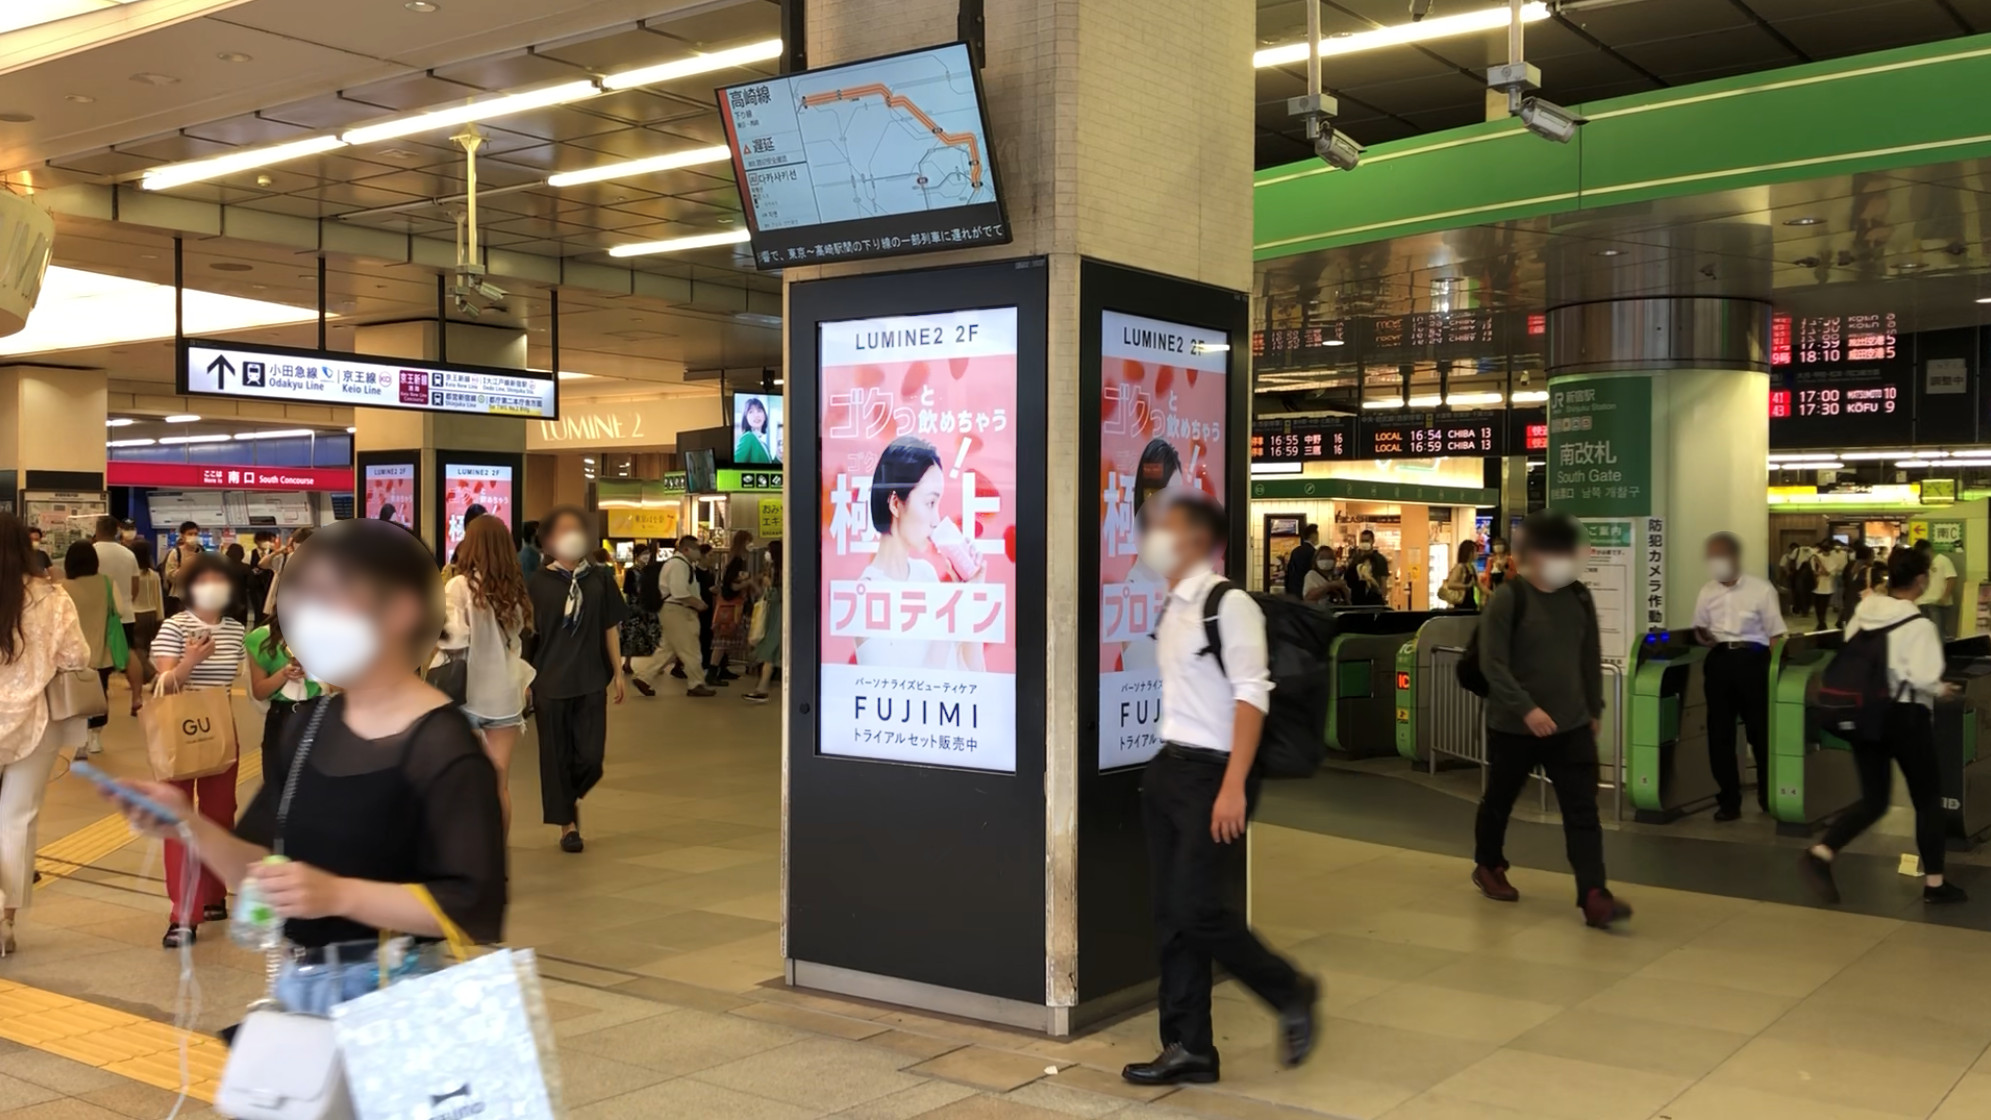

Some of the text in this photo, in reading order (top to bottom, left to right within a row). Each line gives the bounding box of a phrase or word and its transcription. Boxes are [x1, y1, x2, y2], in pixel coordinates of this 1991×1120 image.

[729, 85, 771, 109] 高崎線
[752, 137, 775, 153] 遅延
[758, 168, 797, 183] 다카사키선
[855, 324, 980, 350] LUMINE2 2F
[1123, 326, 1183, 354] LUMINE2
[1800, 350, 1840, 363] 18:10
[1886, 346, 1896, 359] 5
[269, 364, 318, 379] 小田急線
[343, 370, 377, 384] 京王線
[269, 378, 324, 391] Odakyu Line
[342, 384, 382, 395] Keio Line
[1772, 392, 1783, 403] 41
[1800, 390, 1840, 403] 17:00
[1884, 387, 1897, 399] 10
[1772, 405, 1784, 417] 43
[1800, 403, 1840, 416] 17:30
[1885, 401, 1895, 413] 9
[540, 412, 644, 441] LUMINE 2
[1375, 427, 1491, 441] LOCAL 16:54 CHIBA 13
[1270, 434, 1299, 446] 16:55
[1334, 433, 1343, 444] 16
[1375, 440, 1491, 453] LOCAL 16:59 CHIBA 13
[1270, 446, 1299, 456] 16:59
[1334, 445, 1343, 455] 16
[1560, 440, 1617, 466] 南改札
[228, 471, 255, 484] 南口
[259, 475, 314, 485] South Concourse
[1557, 469, 1622, 483] South Gate
[832, 583, 1003, 634] プロテイン
[855, 677, 978, 694] パーソナライズビューティケア
[1398, 674, 1410, 688] IC
[855, 695, 977, 728] FUJIMI
[182, 717, 211, 736] GU
[854, 728, 978, 752] トライアルセット販売中
